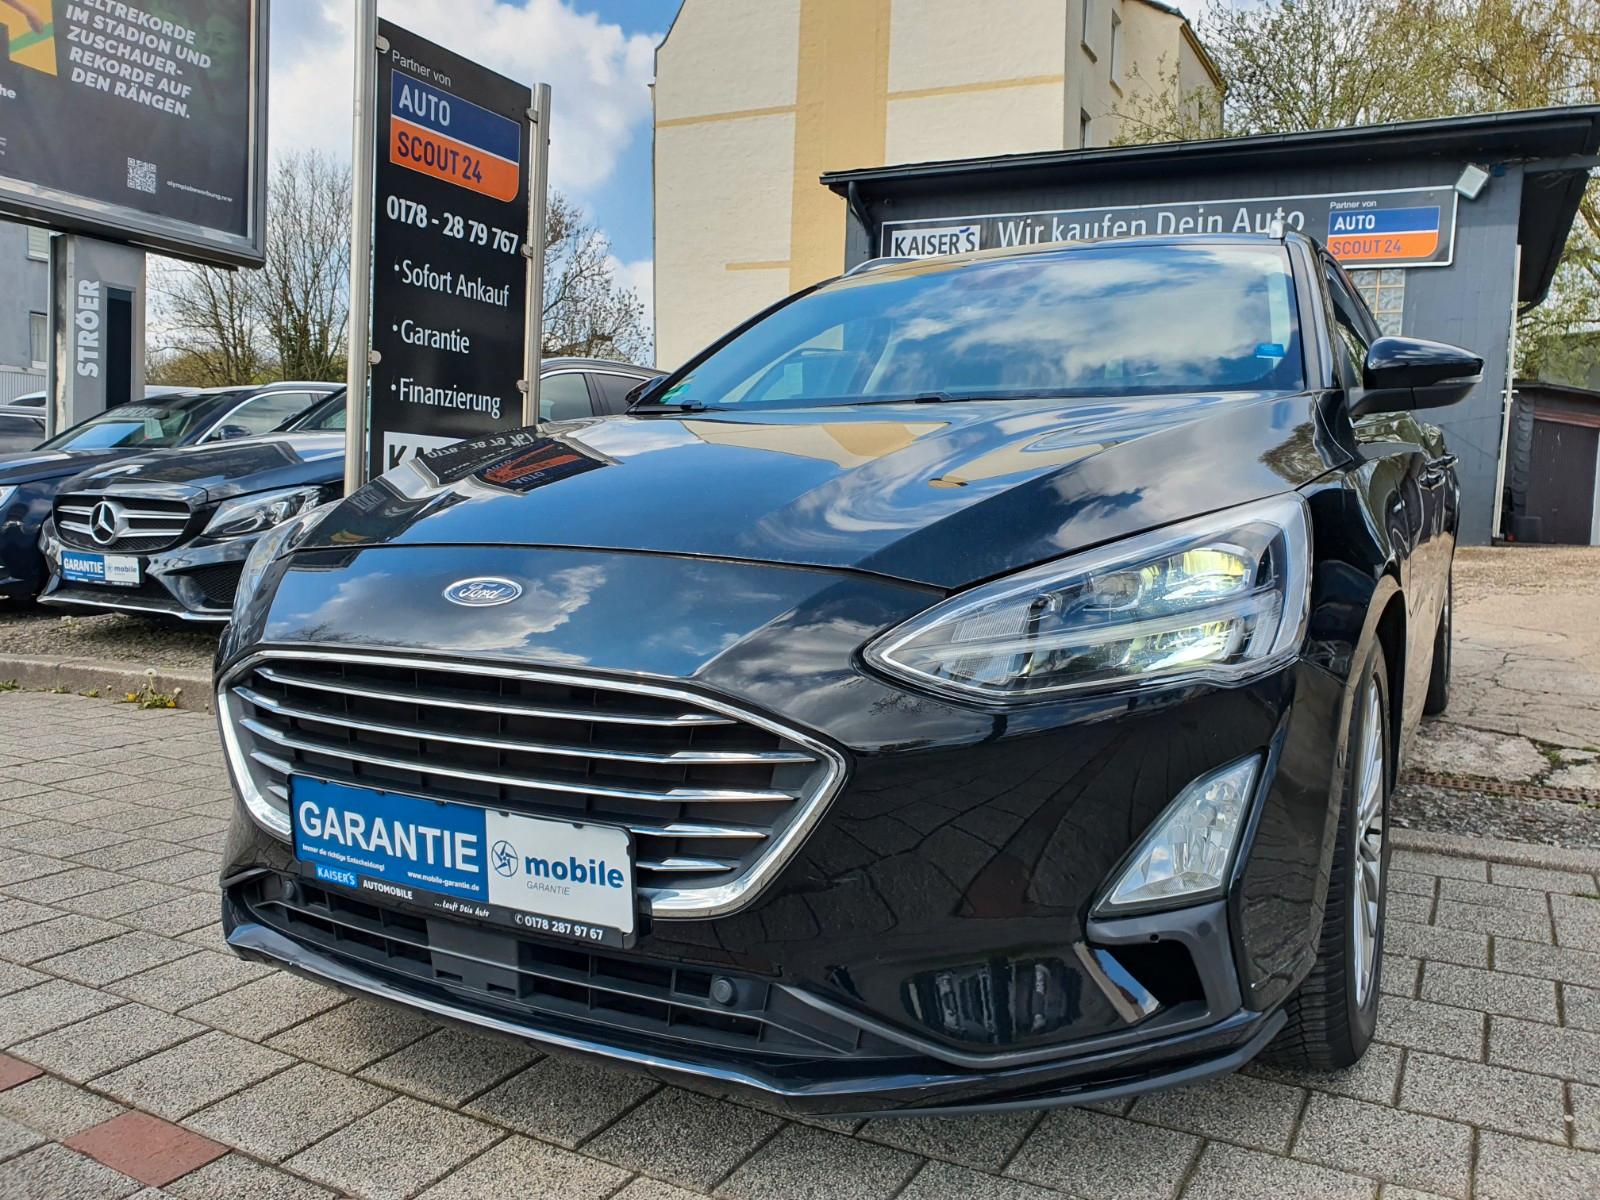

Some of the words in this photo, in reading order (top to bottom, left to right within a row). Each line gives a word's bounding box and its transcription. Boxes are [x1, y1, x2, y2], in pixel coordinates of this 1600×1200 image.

[65, 5, 89, 24] IM
[93, 15, 171, 55] STADION
[175, 45, 211, 68] UND
[67, 25, 183, 76] ZUSCHAUER-
[69, 47, 155, 87] REKORDE
[157, 78, 191, 99] AUF
[392, 49, 431, 77] Partner
[433, 70, 452, 86] von
[72, 67, 111, 92] DEN
[114, 81, 190, 118] RÄNGEN.
[399, 84, 450, 126] AUTO
[1330, 201, 1360, 209] Partner
[1334, 214, 1376, 231] AUTO
[386, 195, 428, 228] 0178
[442, 212, 464, 239] 28
[468, 220, 488, 246] 79
[492, 227, 519, 255] 767
[998, 218, 1045, 248] Wir
[1052, 213, 1147, 242] kaufen
[1157, 208, 1223, 234] Dein
[1232, 206, 1304, 234] Auto
[402, 259, 452, 294] Sofort
[455, 274, 510, 307] Ankauf
[76, 279, 100, 378] STRÖER
[401, 319, 470, 354] Garantie
[399, 377, 501, 420] Finanzierung
[63, 557, 104, 574] GARANTIE
[459, 582, 506, 599] Ford
[299, 801, 480, 873] GARANTIE
[302, 843, 318, 853] Immer
[319, 848, 327, 856] die
[327, 851, 346, 862] richtige
[362, 879, 413, 900] AUTOMOBILE
[407, 871, 480, 891] www.mobile-garantie.de
[525, 855, 625, 889] mobile
[526, 880, 571, 896] GARANTIE
[459, 904, 473, 914] Dein
[475, 906, 490, 918] Auto
[525, 915, 549, 930] 0178
[551, 921, 571, 934] 287
[574, 926, 588, 938] 97
[590, 928, 603, 941] 67
